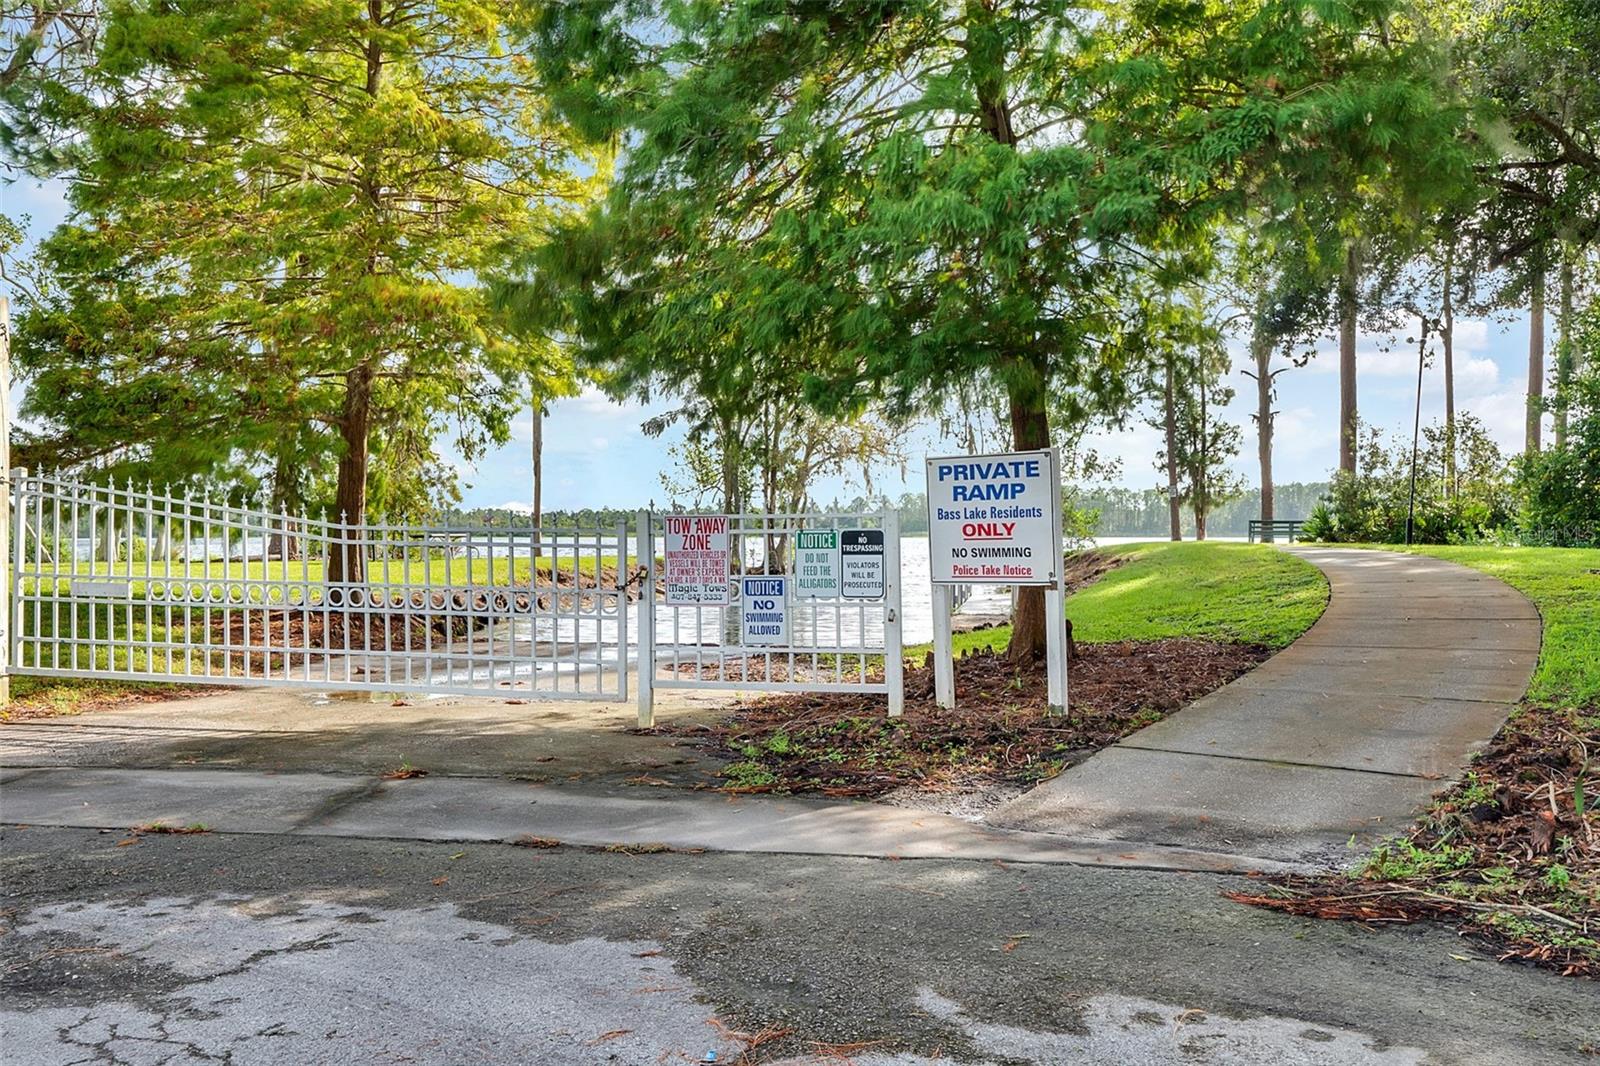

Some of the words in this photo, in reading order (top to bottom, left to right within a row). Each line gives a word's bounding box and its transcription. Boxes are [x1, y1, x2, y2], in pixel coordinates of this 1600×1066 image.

[938, 460, 1040, 482] PRIVATE
[953, 483, 1026, 502] RAMP
[938, 508, 961, 520] Bass
[964, 507, 987, 520] Lake
[990, 506, 1042, 519] Residents
[667, 518, 692, 534] TOW
[696, 518, 726, 534] AWAY
[962, 523, 1016, 537] ONLY
[682, 534, 712, 550] ZONE
[801, 533, 833, 548] NOTICE
[805, 553, 814, 563] DO
[816, 553, 828, 563] NOT
[952, 548, 968, 558] NO
[971, 547, 1032, 558] SWIMMING
[670, 560, 688, 568] VESSELS
[690, 560, 701, 568] WILL
[702, 560, 708, 568] BE
[709, 560, 725, 568] TOWED
[670, 568, 675, 576] AT
[702, 568, 725, 576] EXPENSE
[803, 566, 818, 576] FEED
[820, 566, 831, 576] THE
[953, 565, 979, 576] Police
[981, 565, 1001, 576] Take
[1003, 564, 1032, 576] Notice
[668, 584, 698, 594] Magic
[702, 584, 727, 592] Tows
[748, 581, 780, 595] NOTICE
[798, 579, 837, 589] ALLIGATORS
[753, 600, 775, 610] NO
[746, 613, 783, 623] SWIMMING
[748, 625, 780, 635] ALLOWED
